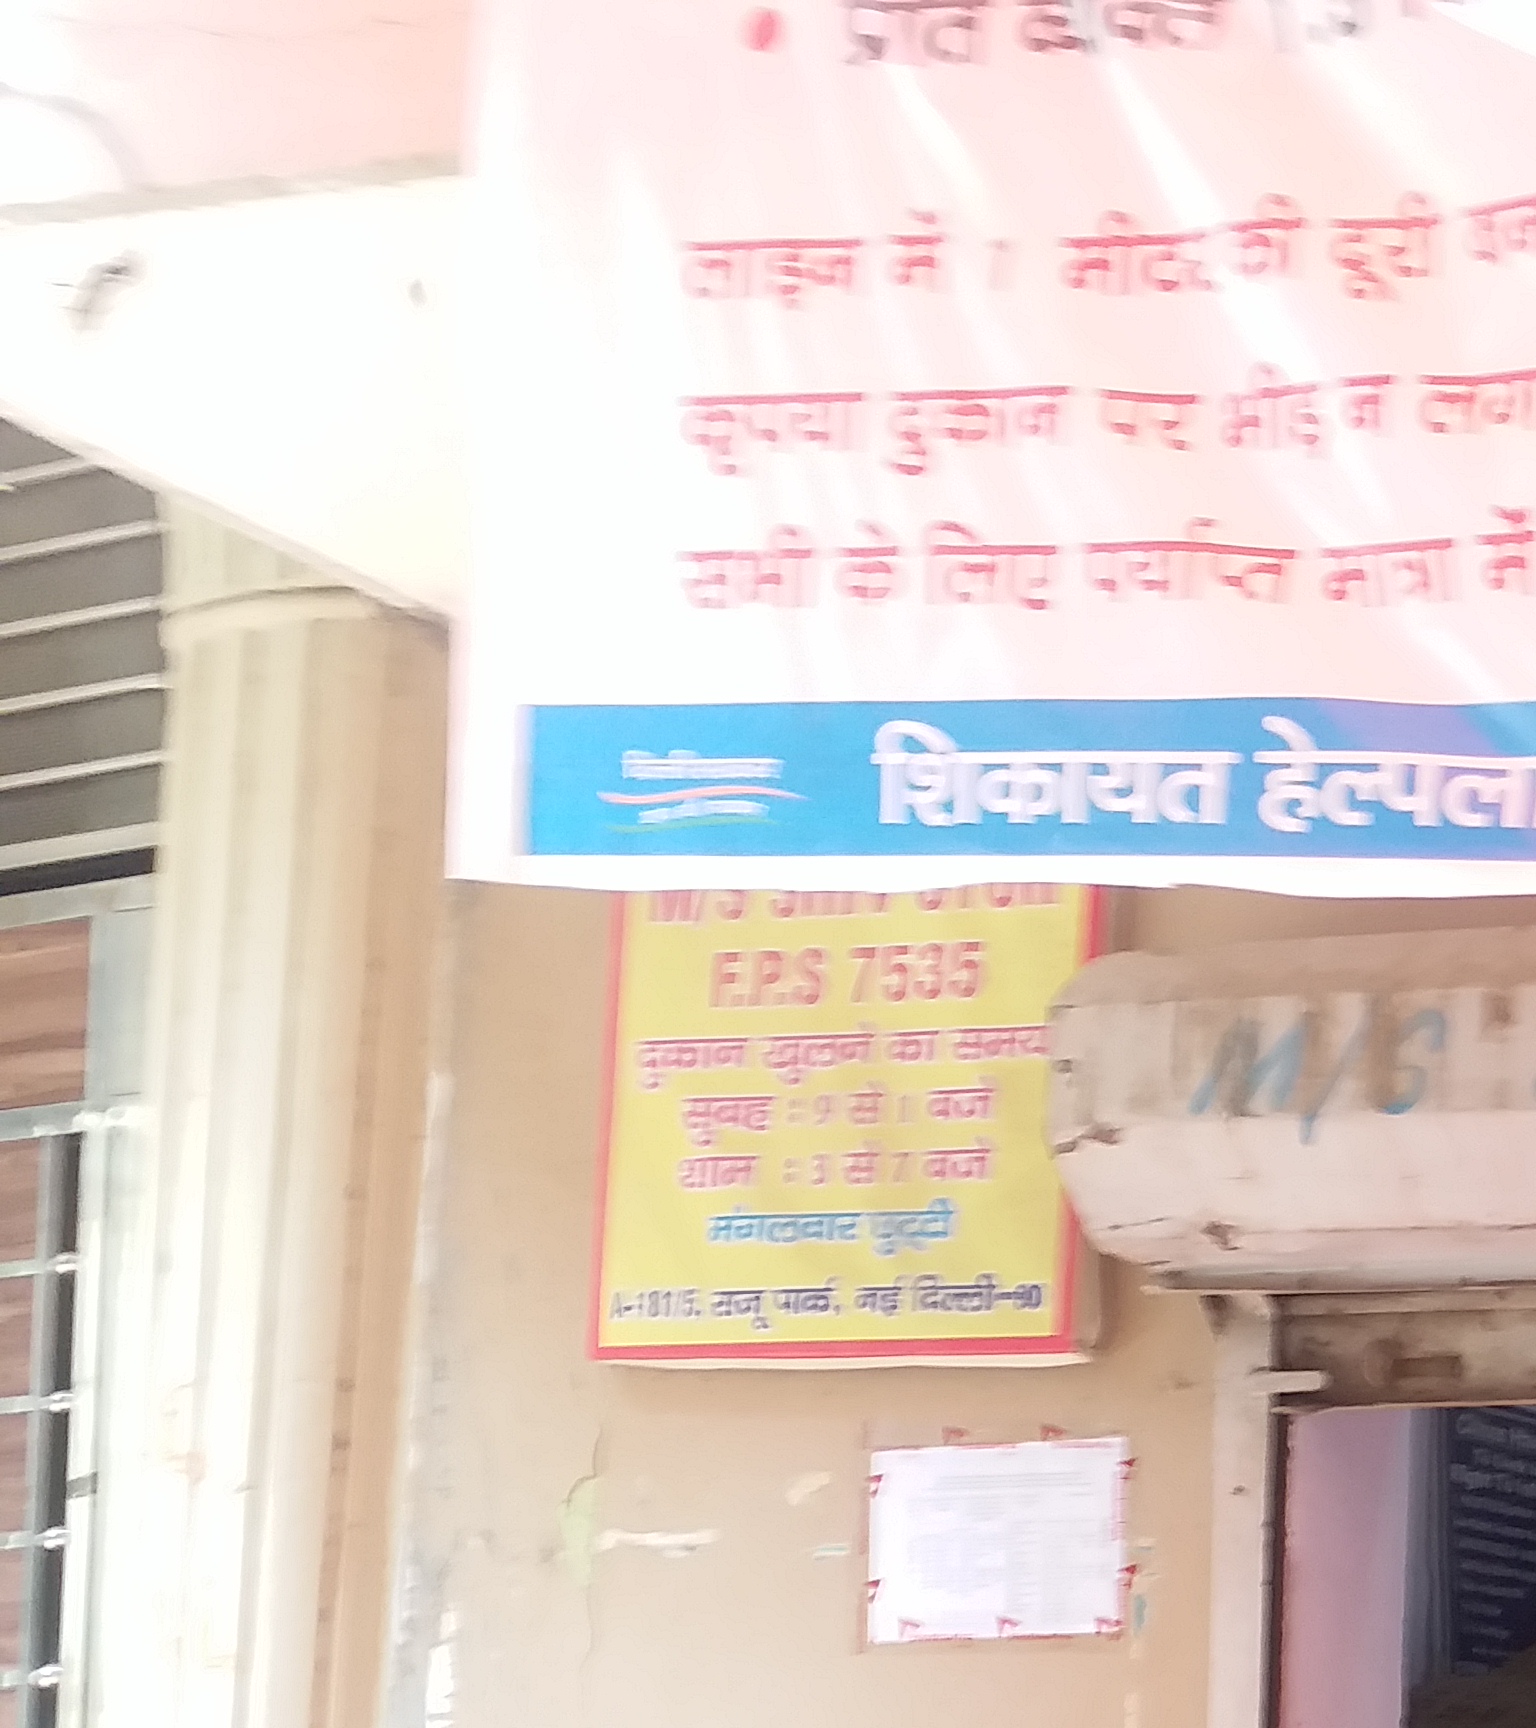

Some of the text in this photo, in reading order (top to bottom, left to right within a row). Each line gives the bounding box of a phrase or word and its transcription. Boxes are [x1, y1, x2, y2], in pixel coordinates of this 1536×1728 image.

[1096, 387, 1204, 452] पर
[834, 518, 902, 602] के
[924, 519, 1060, 611] लिए
[870, 717, 1246, 828] शिकायत
[848, 940, 986, 1003] 7535
[636, 1036, 751, 1090] दुकान
[763, 1021, 876, 1086] खुलने
[886, 1029, 941, 1062] का
[847, 1081, 887, 1127] से
[677, 1153, 760, 1188] शाम
[841, 1137, 880, 1186] से
[707, 1205, 863, 1244] मंगलवार
